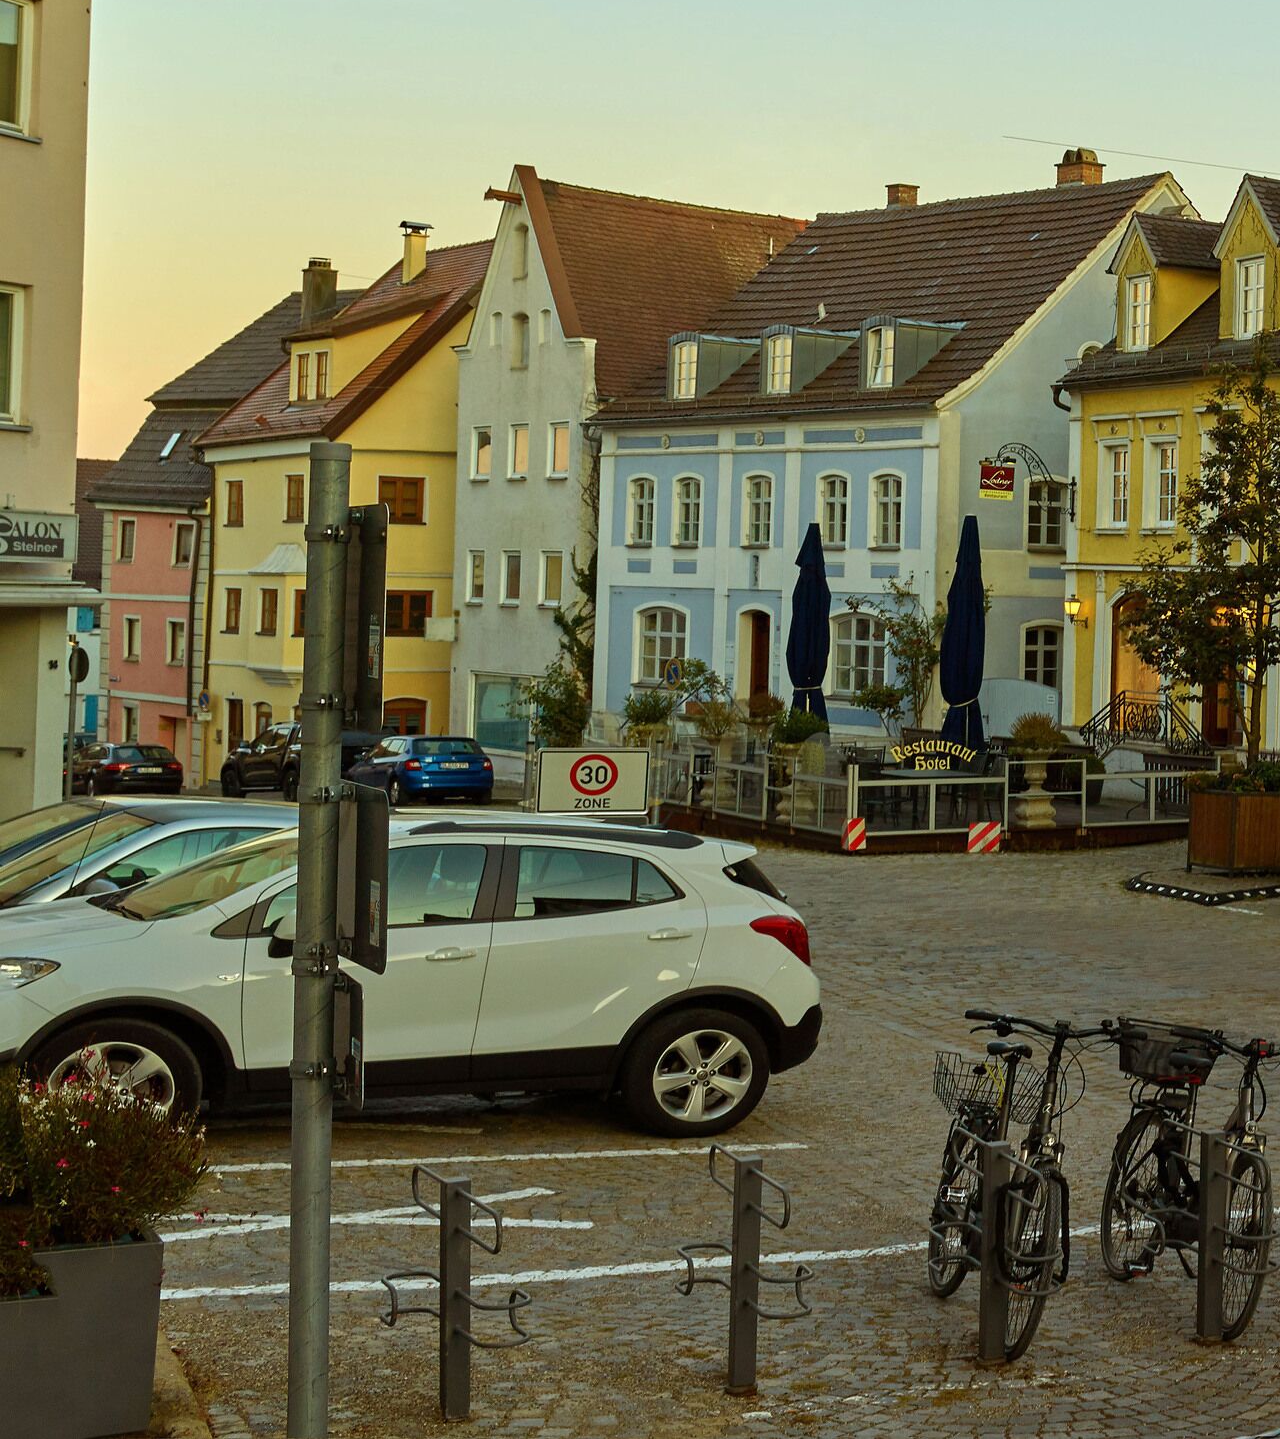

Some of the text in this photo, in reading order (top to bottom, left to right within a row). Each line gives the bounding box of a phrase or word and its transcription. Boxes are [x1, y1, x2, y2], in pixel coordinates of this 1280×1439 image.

[13, 541, 58, 553] Steiner
[890, 738, 977, 763] Restaurant
[915, 755, 951, 771] Hotel
[579, 765, 609, 785] 30
[574, 798, 611, 809] ZONE
